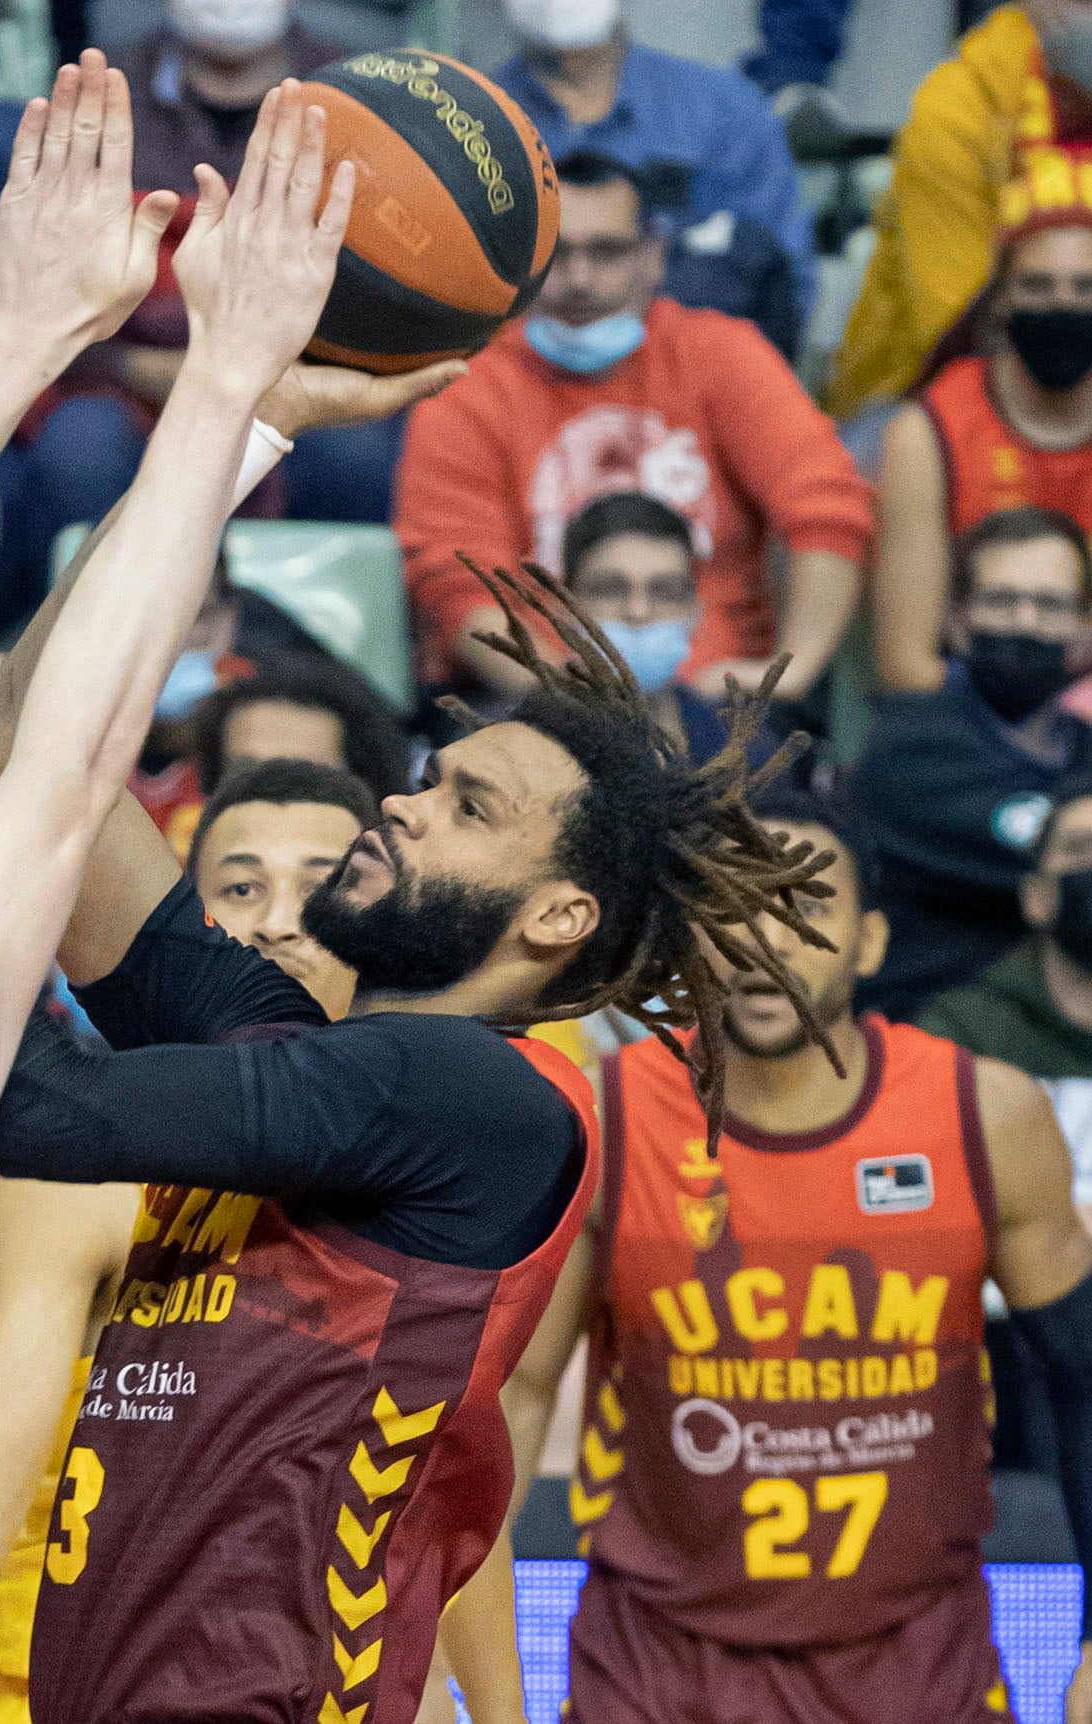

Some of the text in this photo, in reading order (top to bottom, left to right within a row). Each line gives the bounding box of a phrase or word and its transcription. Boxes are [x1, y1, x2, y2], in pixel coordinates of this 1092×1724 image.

[651, 1267, 950, 1356] UCAM
[668, 1348, 940, 1402] UNIVERSIDAD
[741, 1471, 889, 1581] 27
